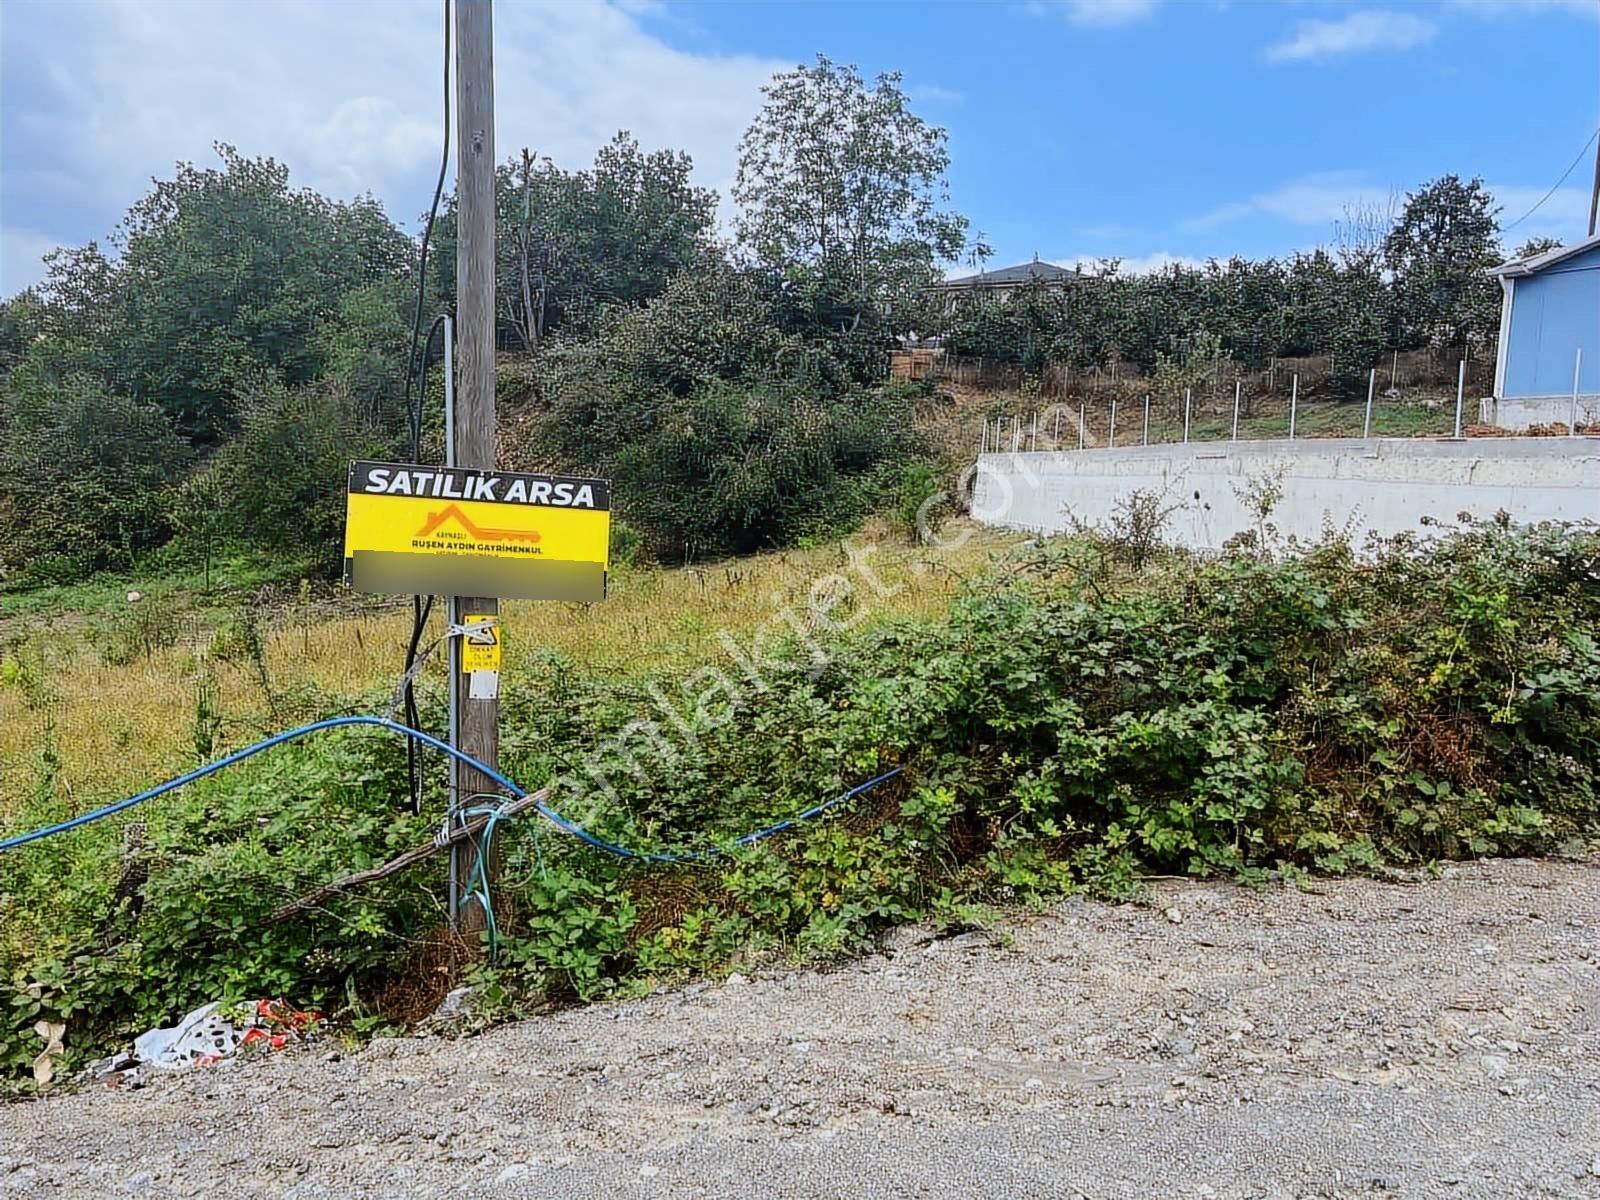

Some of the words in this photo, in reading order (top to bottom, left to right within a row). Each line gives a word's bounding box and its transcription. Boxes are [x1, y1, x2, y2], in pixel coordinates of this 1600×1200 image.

[366, 469, 501, 500] SATILIK
[503, 481, 595, 507] ARSA
[412, 540, 444, 550] RUŞEN
